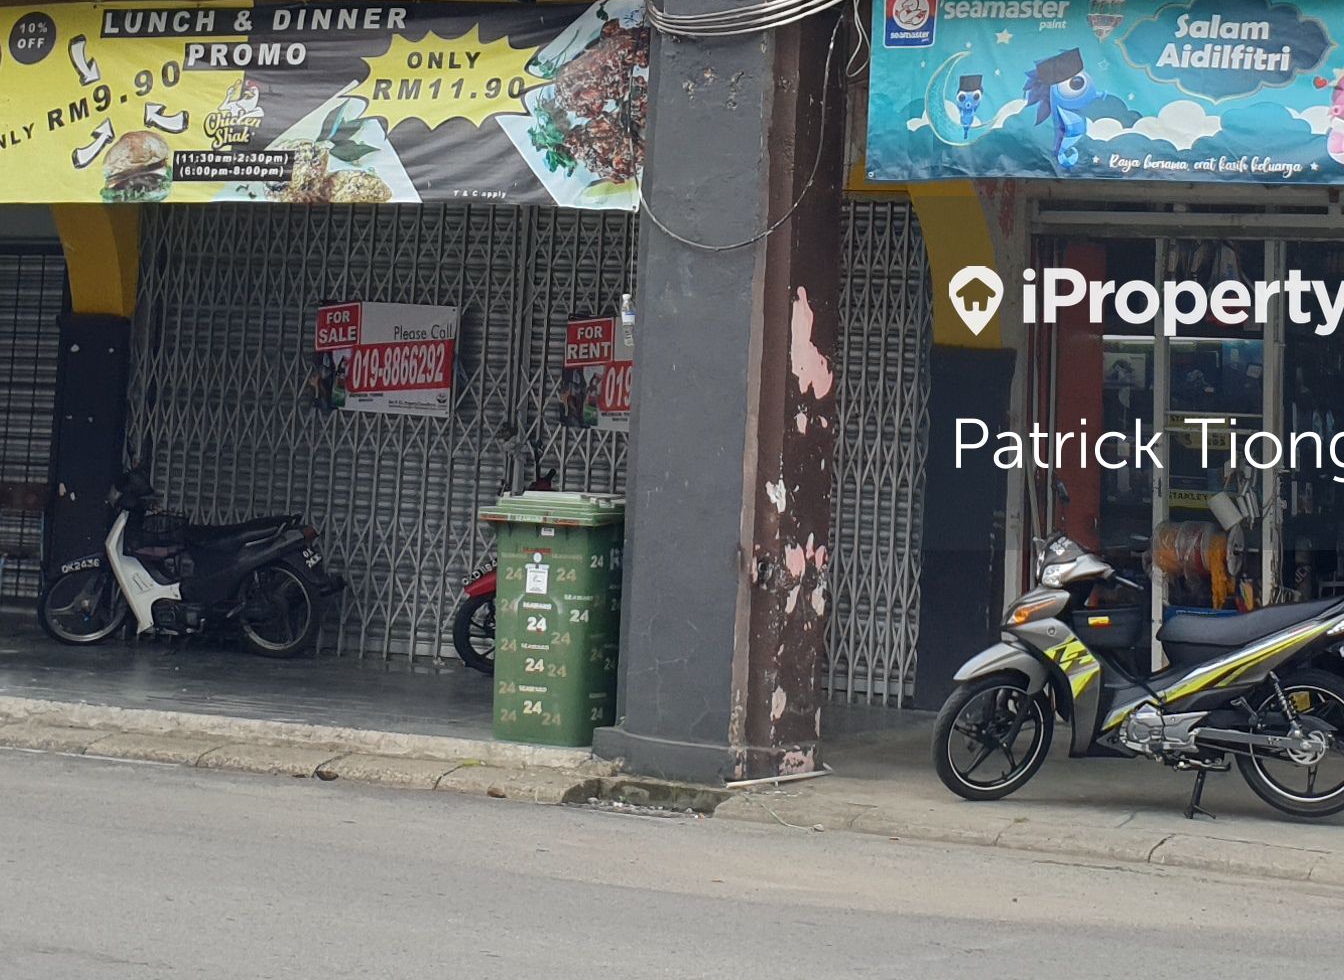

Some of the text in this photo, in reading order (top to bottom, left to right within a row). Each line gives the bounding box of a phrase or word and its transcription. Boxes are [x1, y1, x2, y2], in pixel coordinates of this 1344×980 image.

[19, 22, 48, 34] 10%
[104, 7, 407, 34] LUNCH & DINNER
[1038, 19, 1067, 32] paint
[1174, 13, 1270, 40] Salam
[17, 37, 46, 49] OFF
[187, 42, 307, 67] PROMO
[407, 51, 482, 69] ONLY
[1156, 42, 1291, 71] Aidilfitri
[47, 60, 181, 131] RM9.90
[372, 76, 526, 100] RM11.90
[204, 111, 262, 140] Chicken
[213, 124, 252, 151] Shak
[1109, 153, 1140, 173] Raya
[482, 190, 506, 199] apply
[326, 310, 351, 324] FOR
[318, 326, 357, 343] SALE
[394, 323, 453, 340] Please Call
[577, 325, 603, 340] FOR
[567, 342, 611, 360] RENT
[352, 342, 445, 389] 019-8866292
[590, 555, 604, 568] 24
[557, 568, 577, 582] 24
[526, 616, 547, 631] 24
[569, 609, 590, 622] 24
[525, 658, 545, 672] 24
[523, 700, 543, 714] 24
